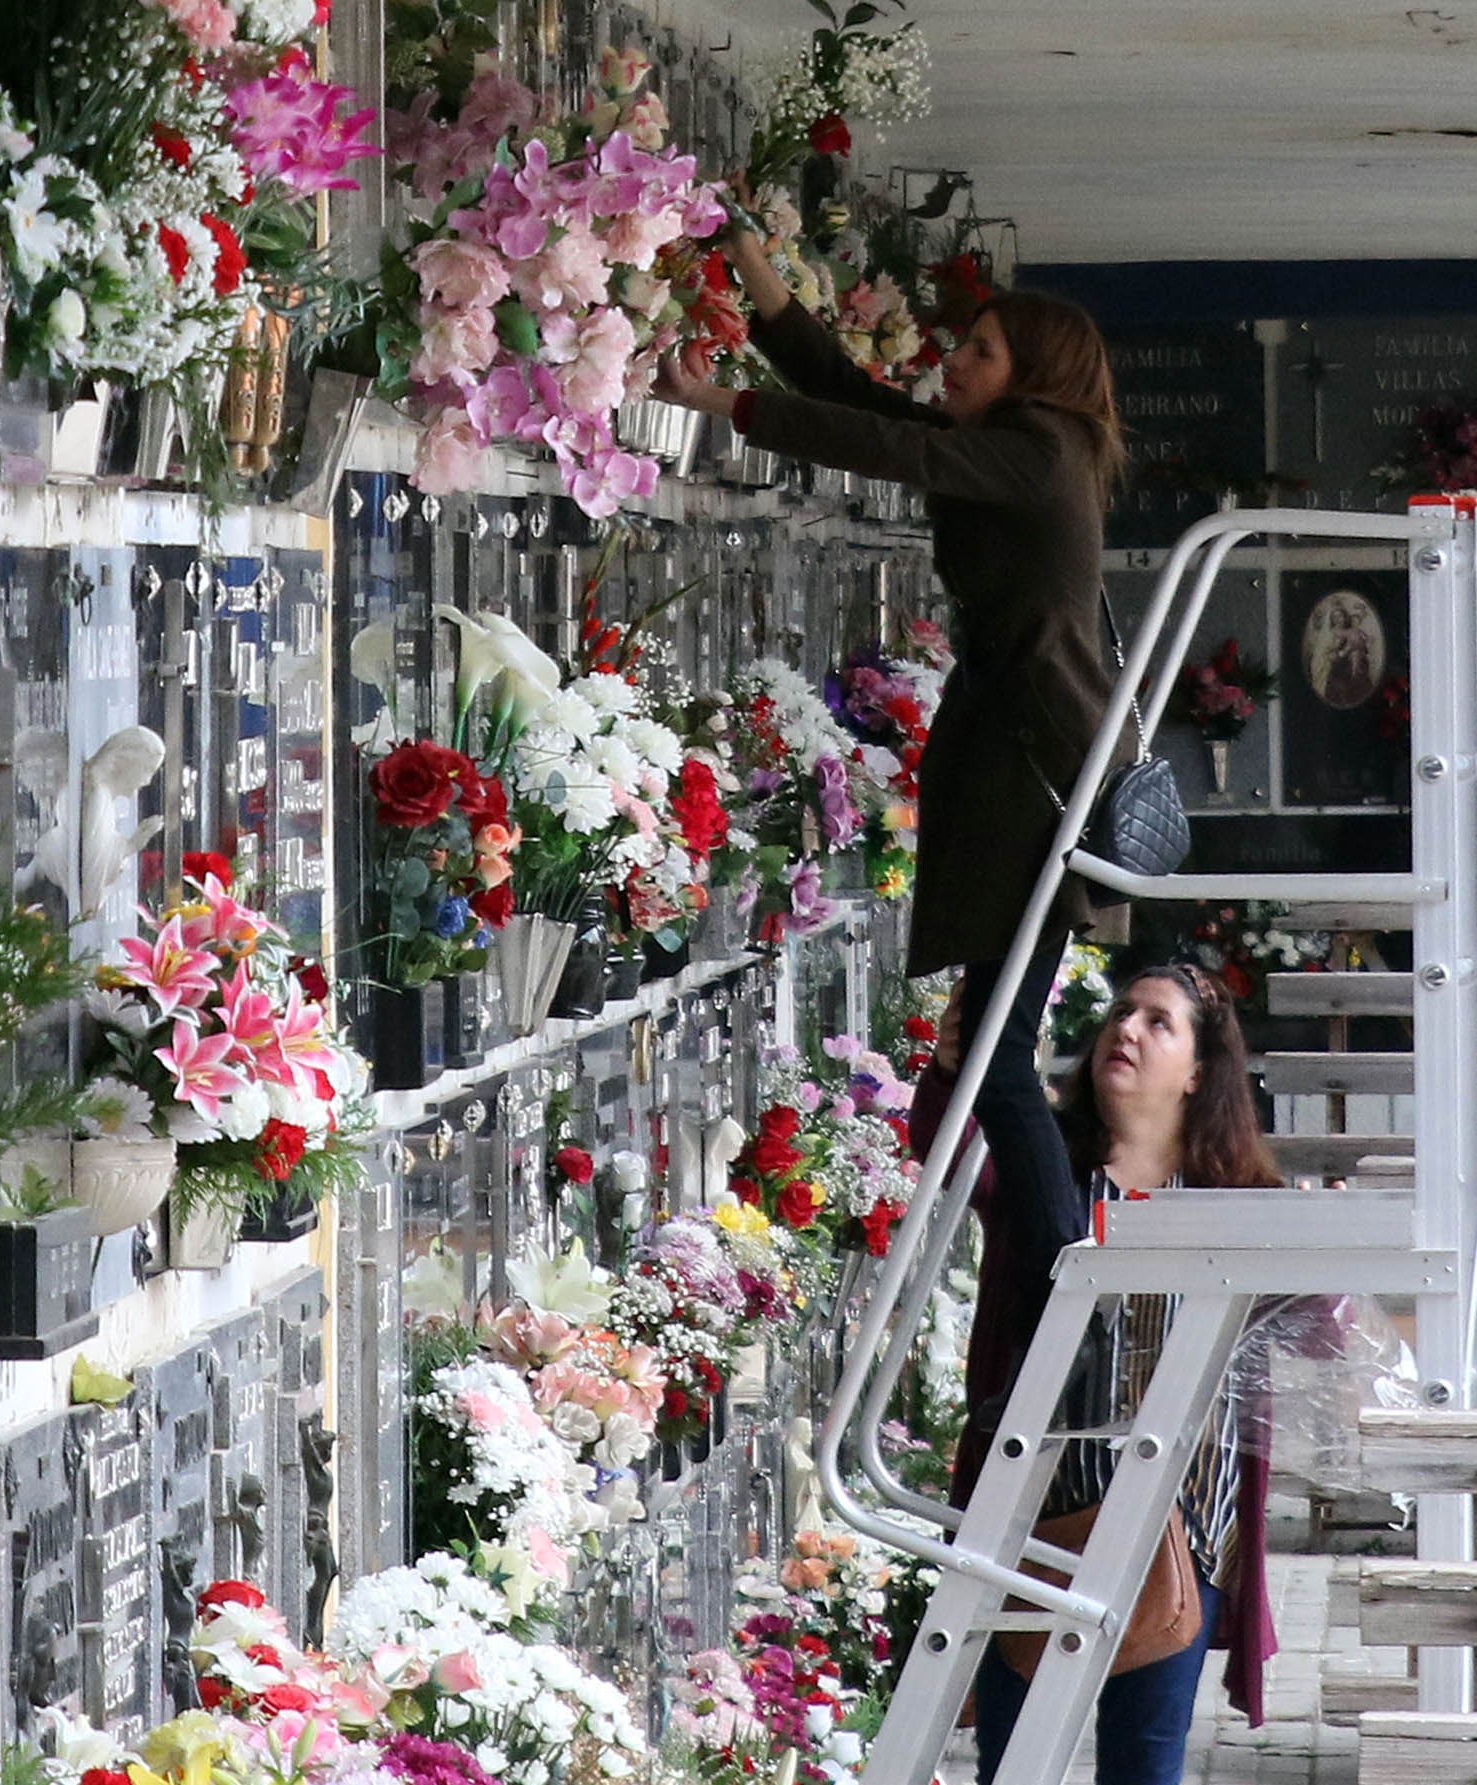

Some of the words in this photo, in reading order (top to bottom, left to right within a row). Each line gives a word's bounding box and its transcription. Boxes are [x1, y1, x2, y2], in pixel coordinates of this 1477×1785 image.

[1374, 335, 1469, 358] FAMILIA
[1374, 370, 1461, 390] VILLAS
[1126, 550, 1151, 567] 14
